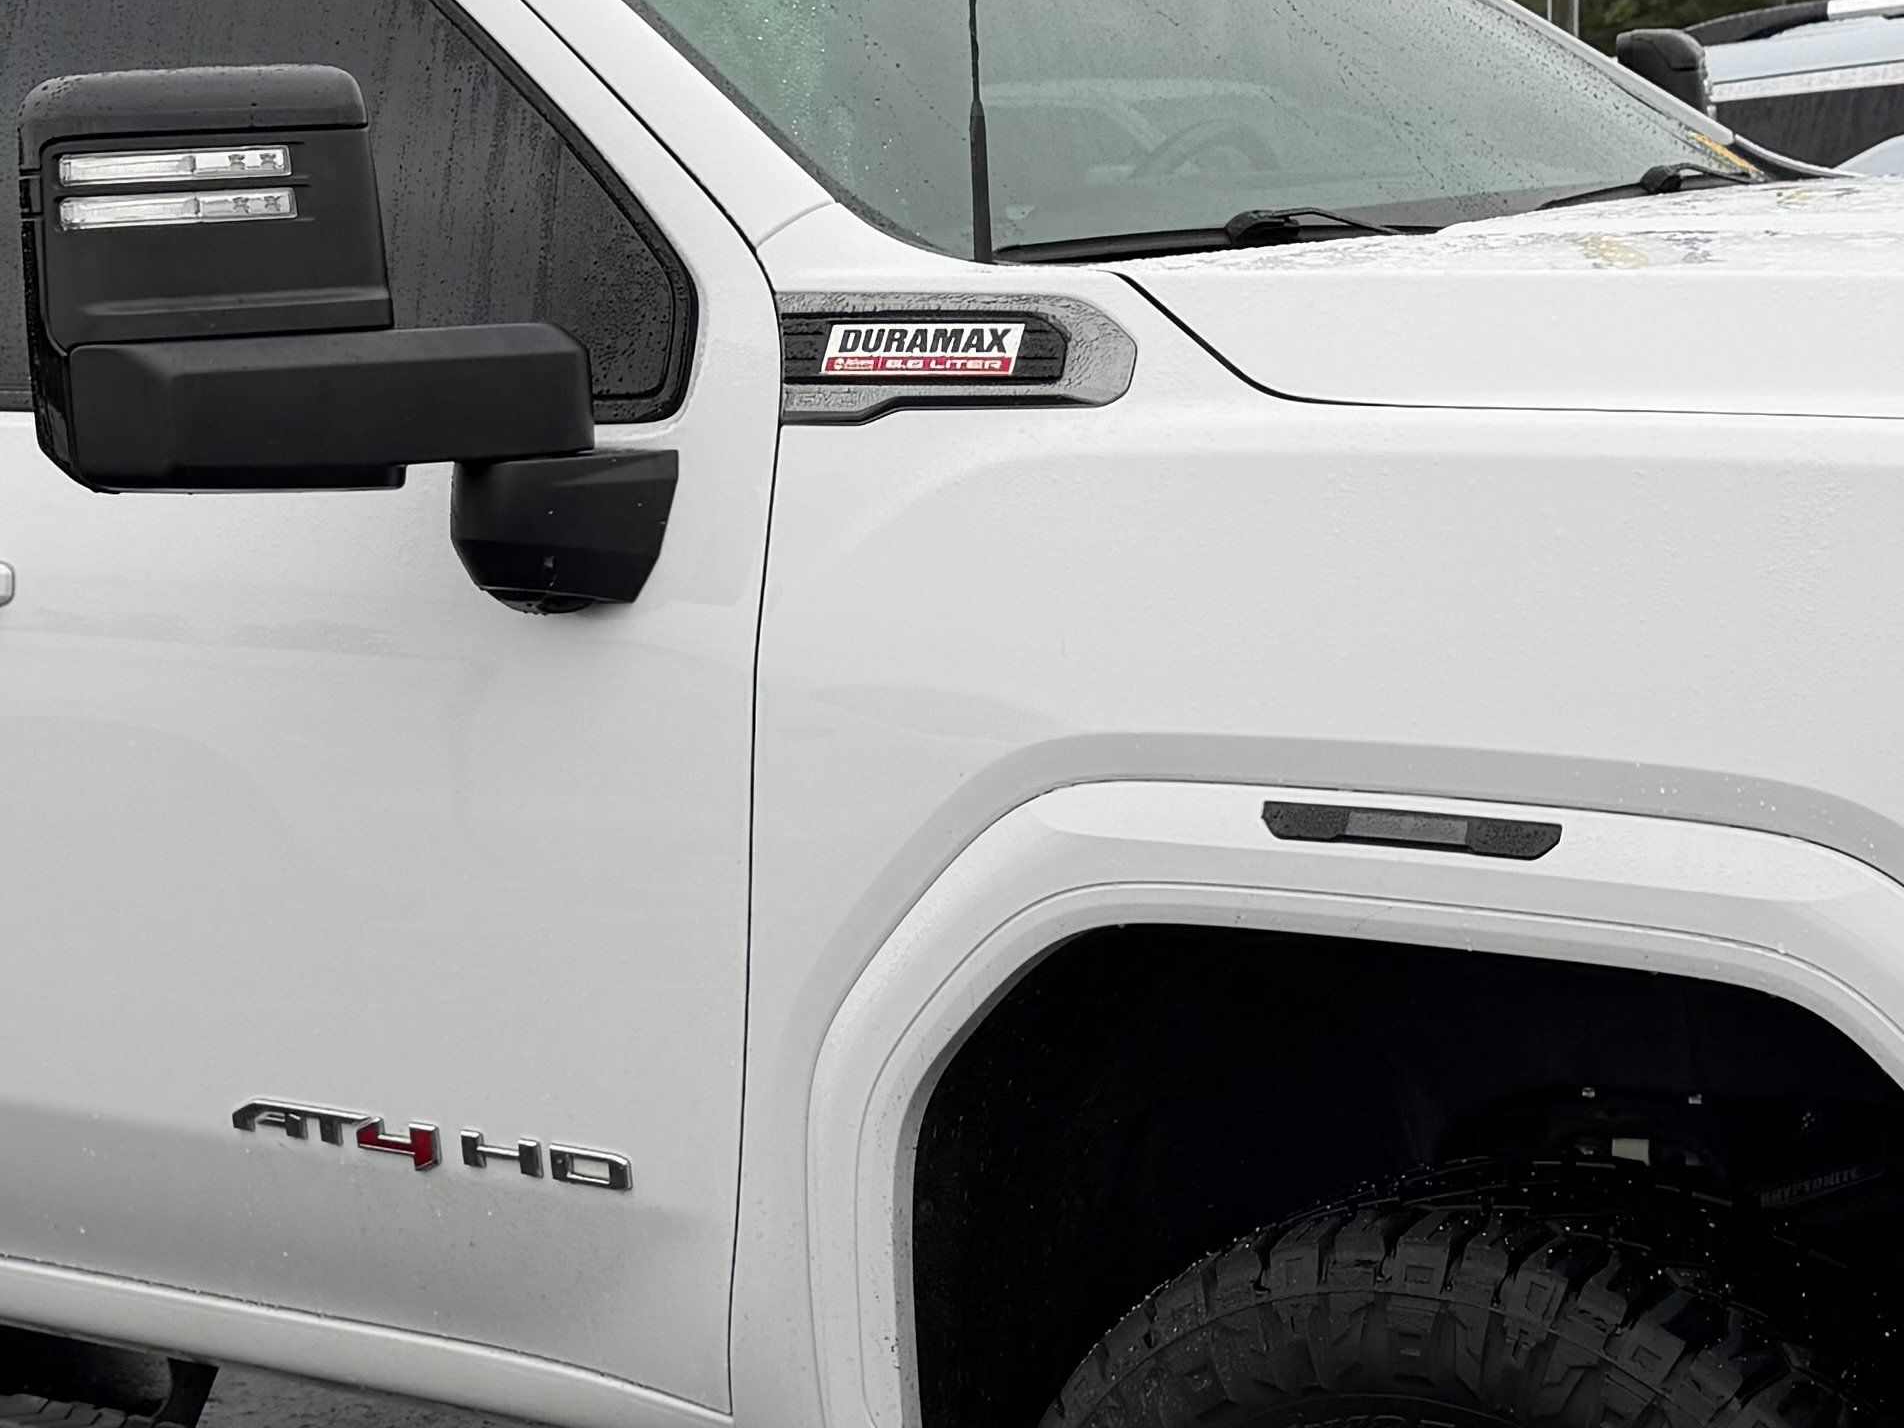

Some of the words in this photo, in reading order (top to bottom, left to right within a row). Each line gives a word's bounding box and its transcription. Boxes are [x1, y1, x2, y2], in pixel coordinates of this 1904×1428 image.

[838, 327, 1012, 354] DURAMAX
[929, 358, 1002, 370] LITER
[231, 1096, 442, 1172] AT4
[460, 1127, 633, 1191] HD
